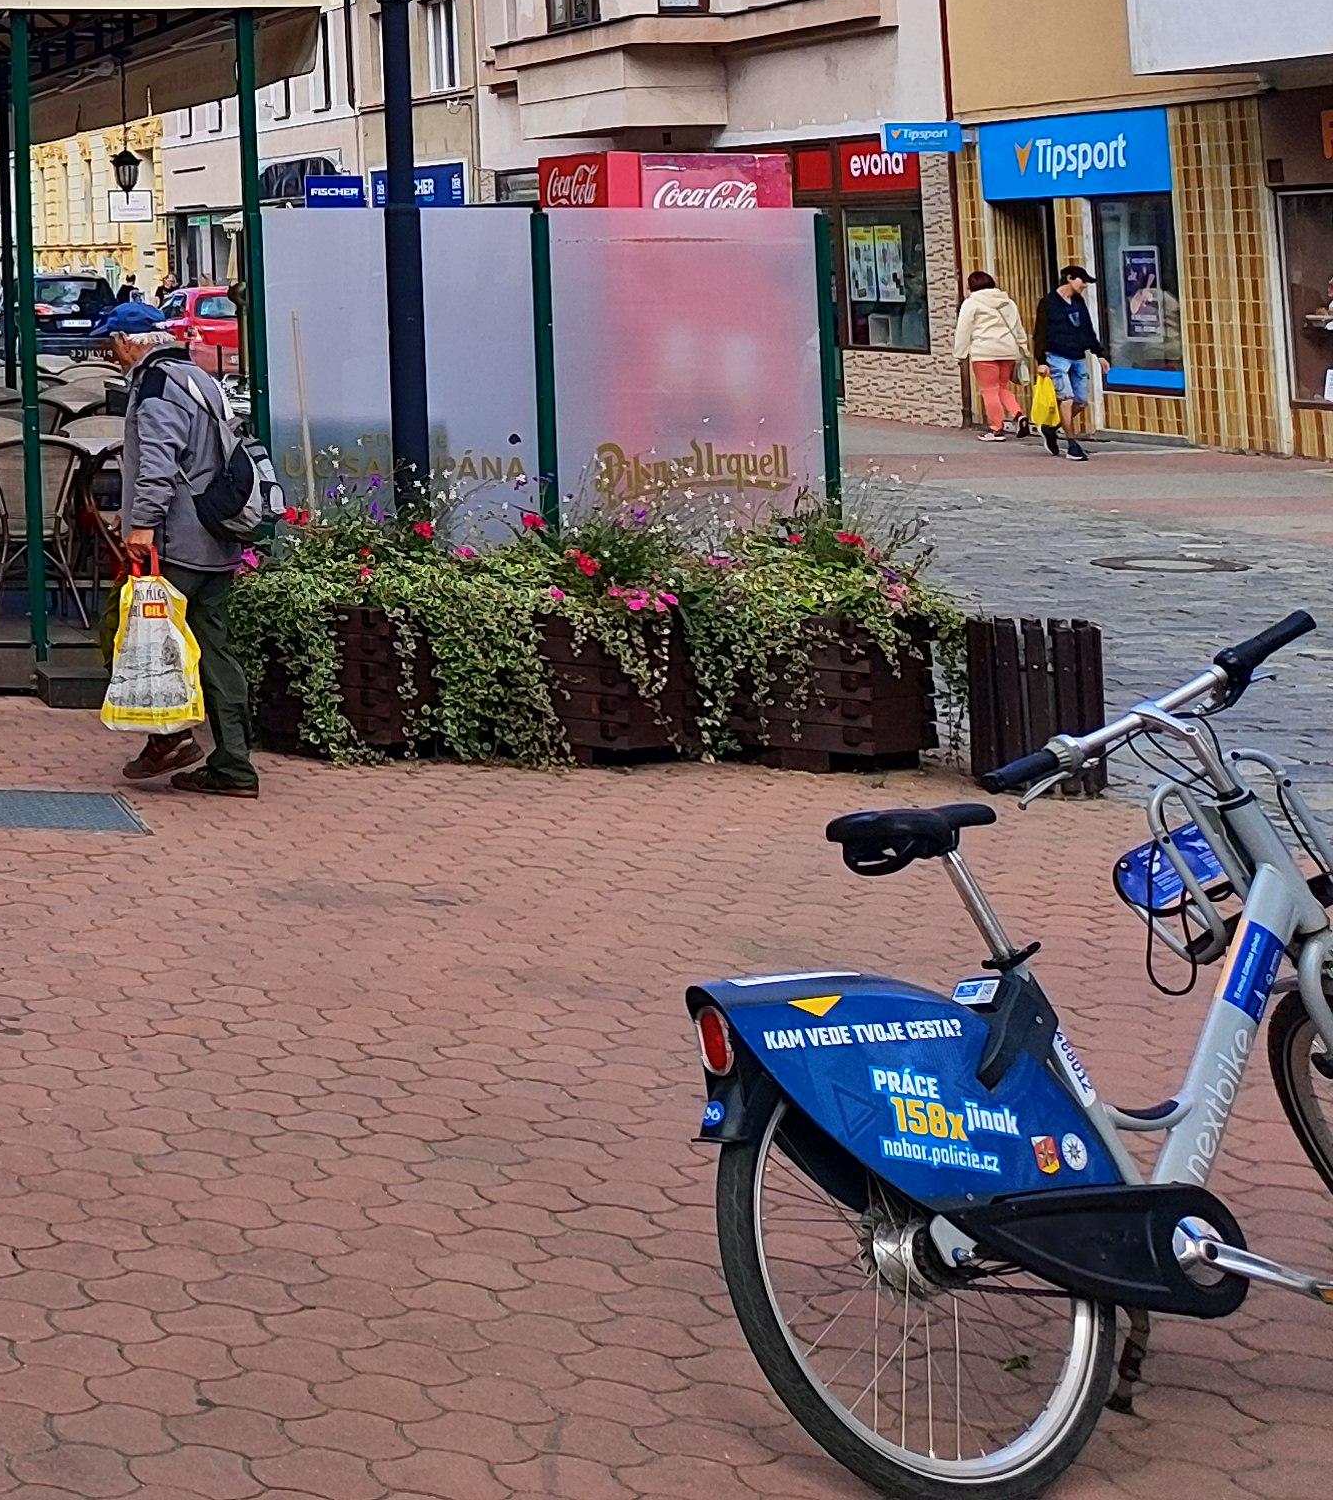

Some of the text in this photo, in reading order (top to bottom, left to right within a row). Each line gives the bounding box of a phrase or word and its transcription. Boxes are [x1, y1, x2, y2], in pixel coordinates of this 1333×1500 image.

[902, 128, 949, 141] Tipsport
[849, 151, 904, 177] evona
[1035, 132, 1126, 180] Tipsport
[310, 187, 359, 197] FISCHER
[283, 451, 306, 478] U
[436, 449, 528, 481] PÁNA
[689, 438, 790, 492] Urquell
[763, 1018, 963, 1050] KAM VEDE TVOJE CESTA?
[872, 1067, 941, 1099] PRÁCE
[889, 1096, 1021, 1142] 158x jinak
[1184, 1027, 1253, 1183] nextbike
[882, 1137, 1001, 1173] nabor.policie.cz
